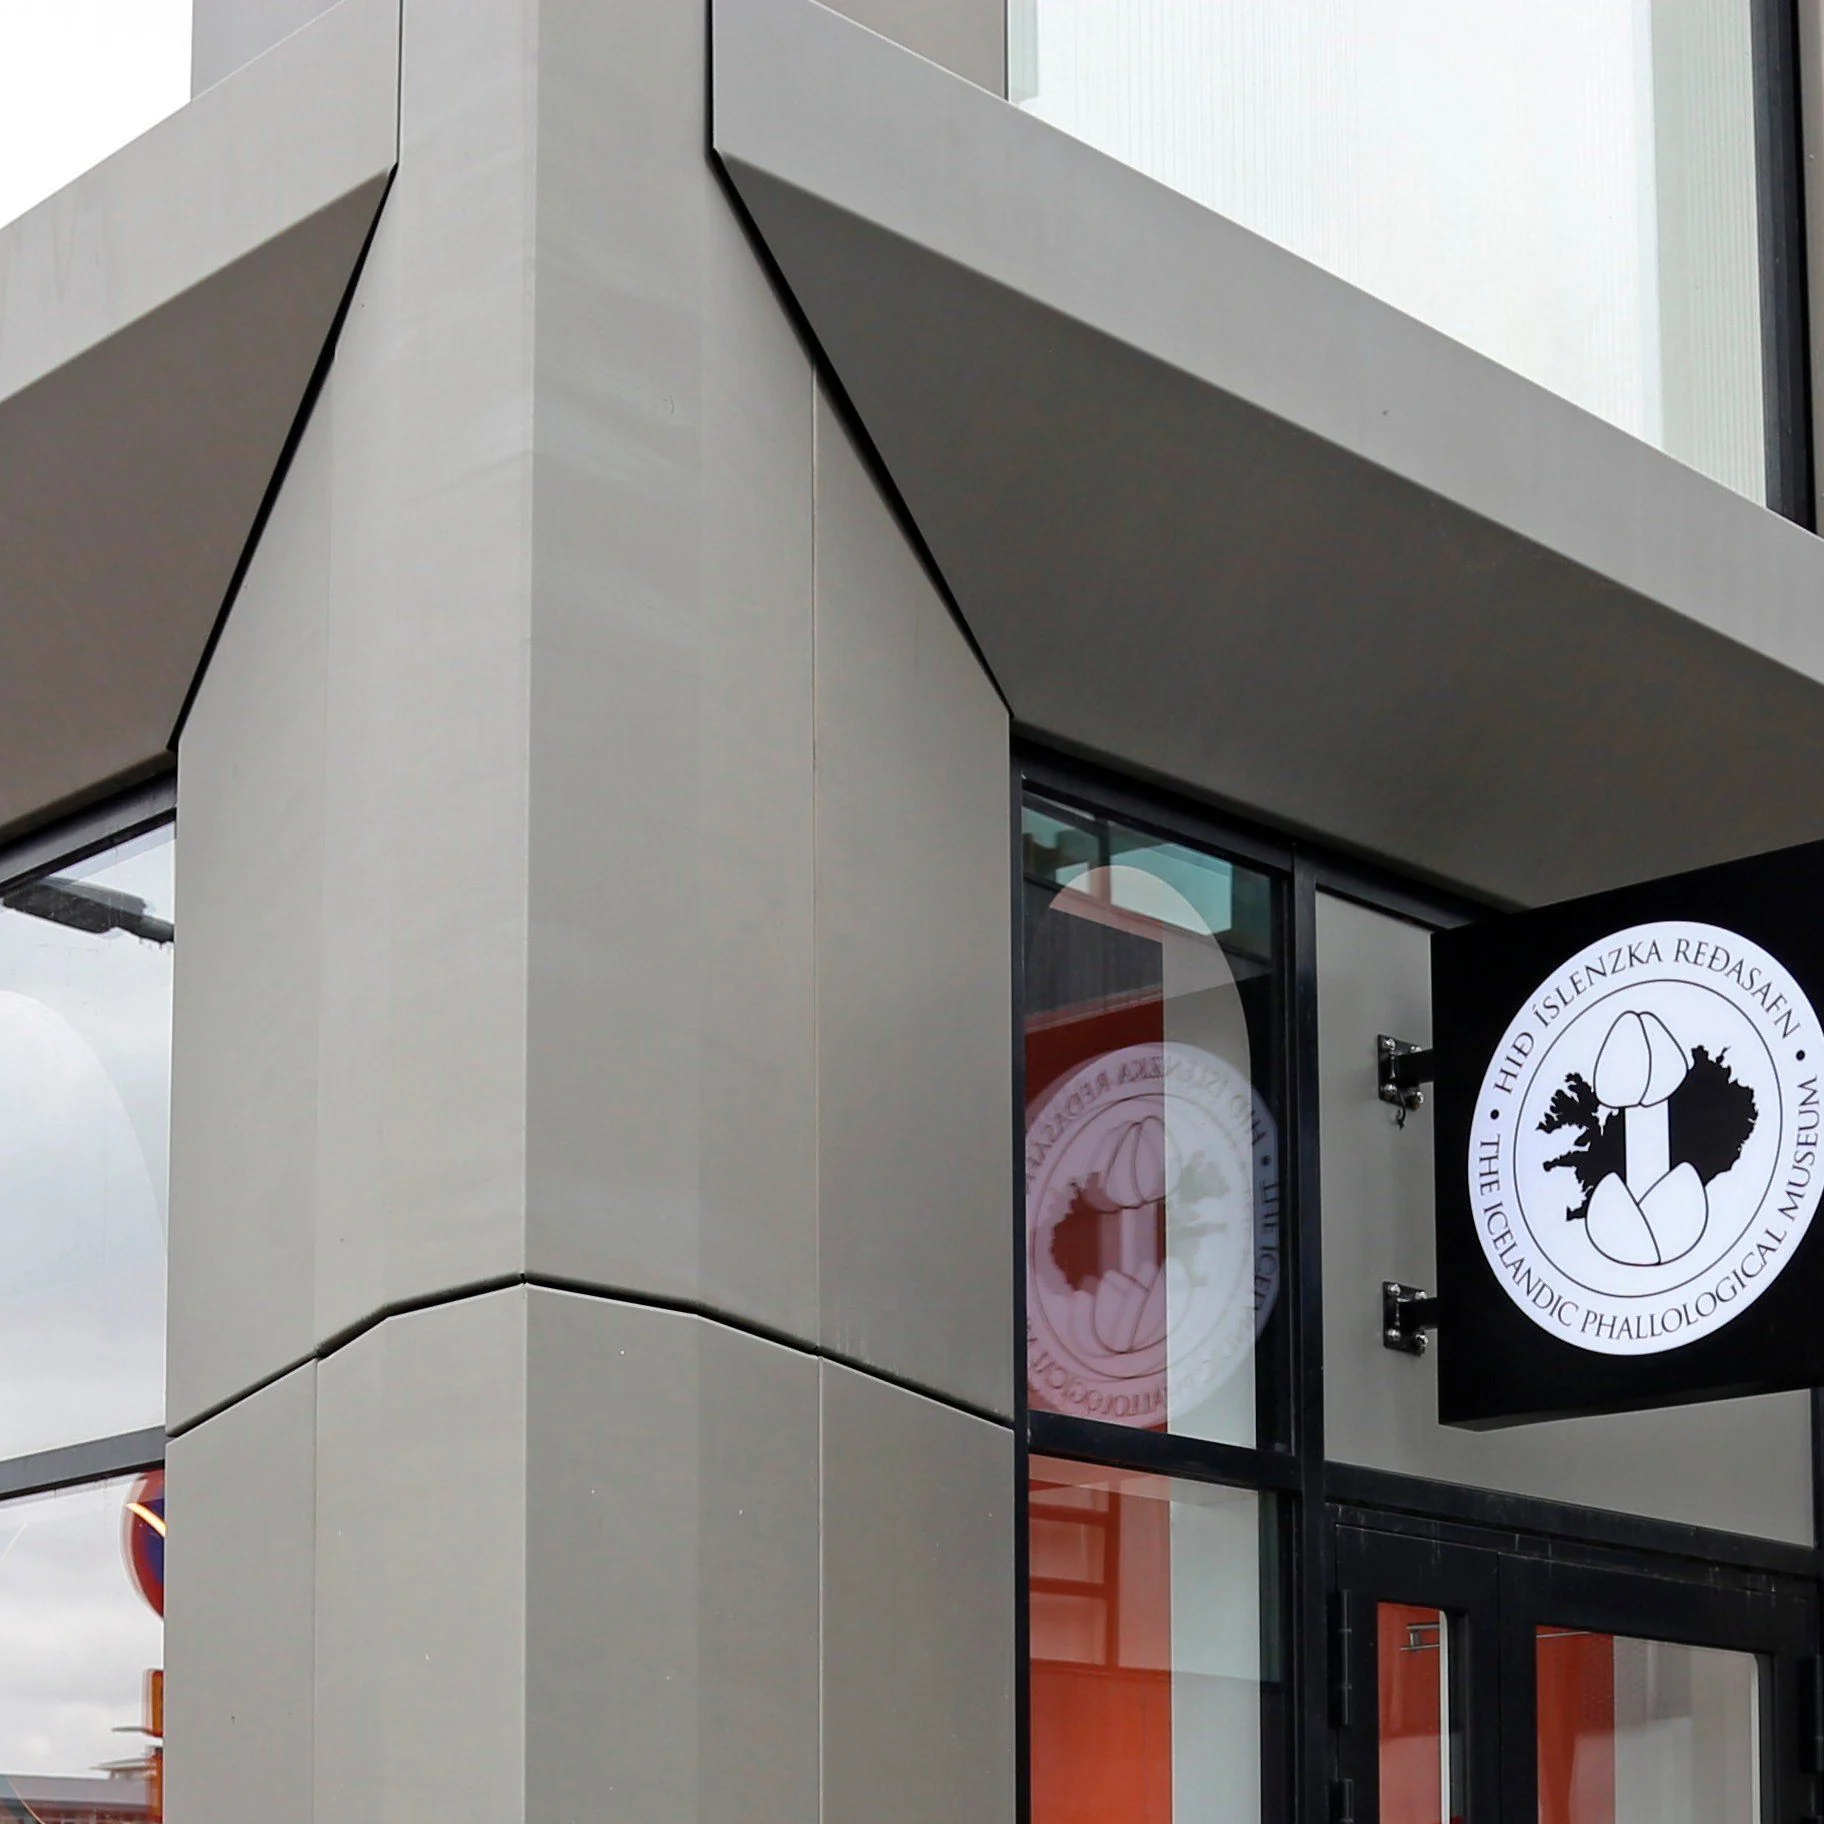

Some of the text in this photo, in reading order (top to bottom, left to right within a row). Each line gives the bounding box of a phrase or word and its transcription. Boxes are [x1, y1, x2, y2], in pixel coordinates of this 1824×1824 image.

[1495, 938, 1802, 1096] HIÐ ÍSLENZKA REÐASAFN
[1478, 1075, 1820, 1340] THE ICELANDIC PHALLOLOGICAL MUSEUM
